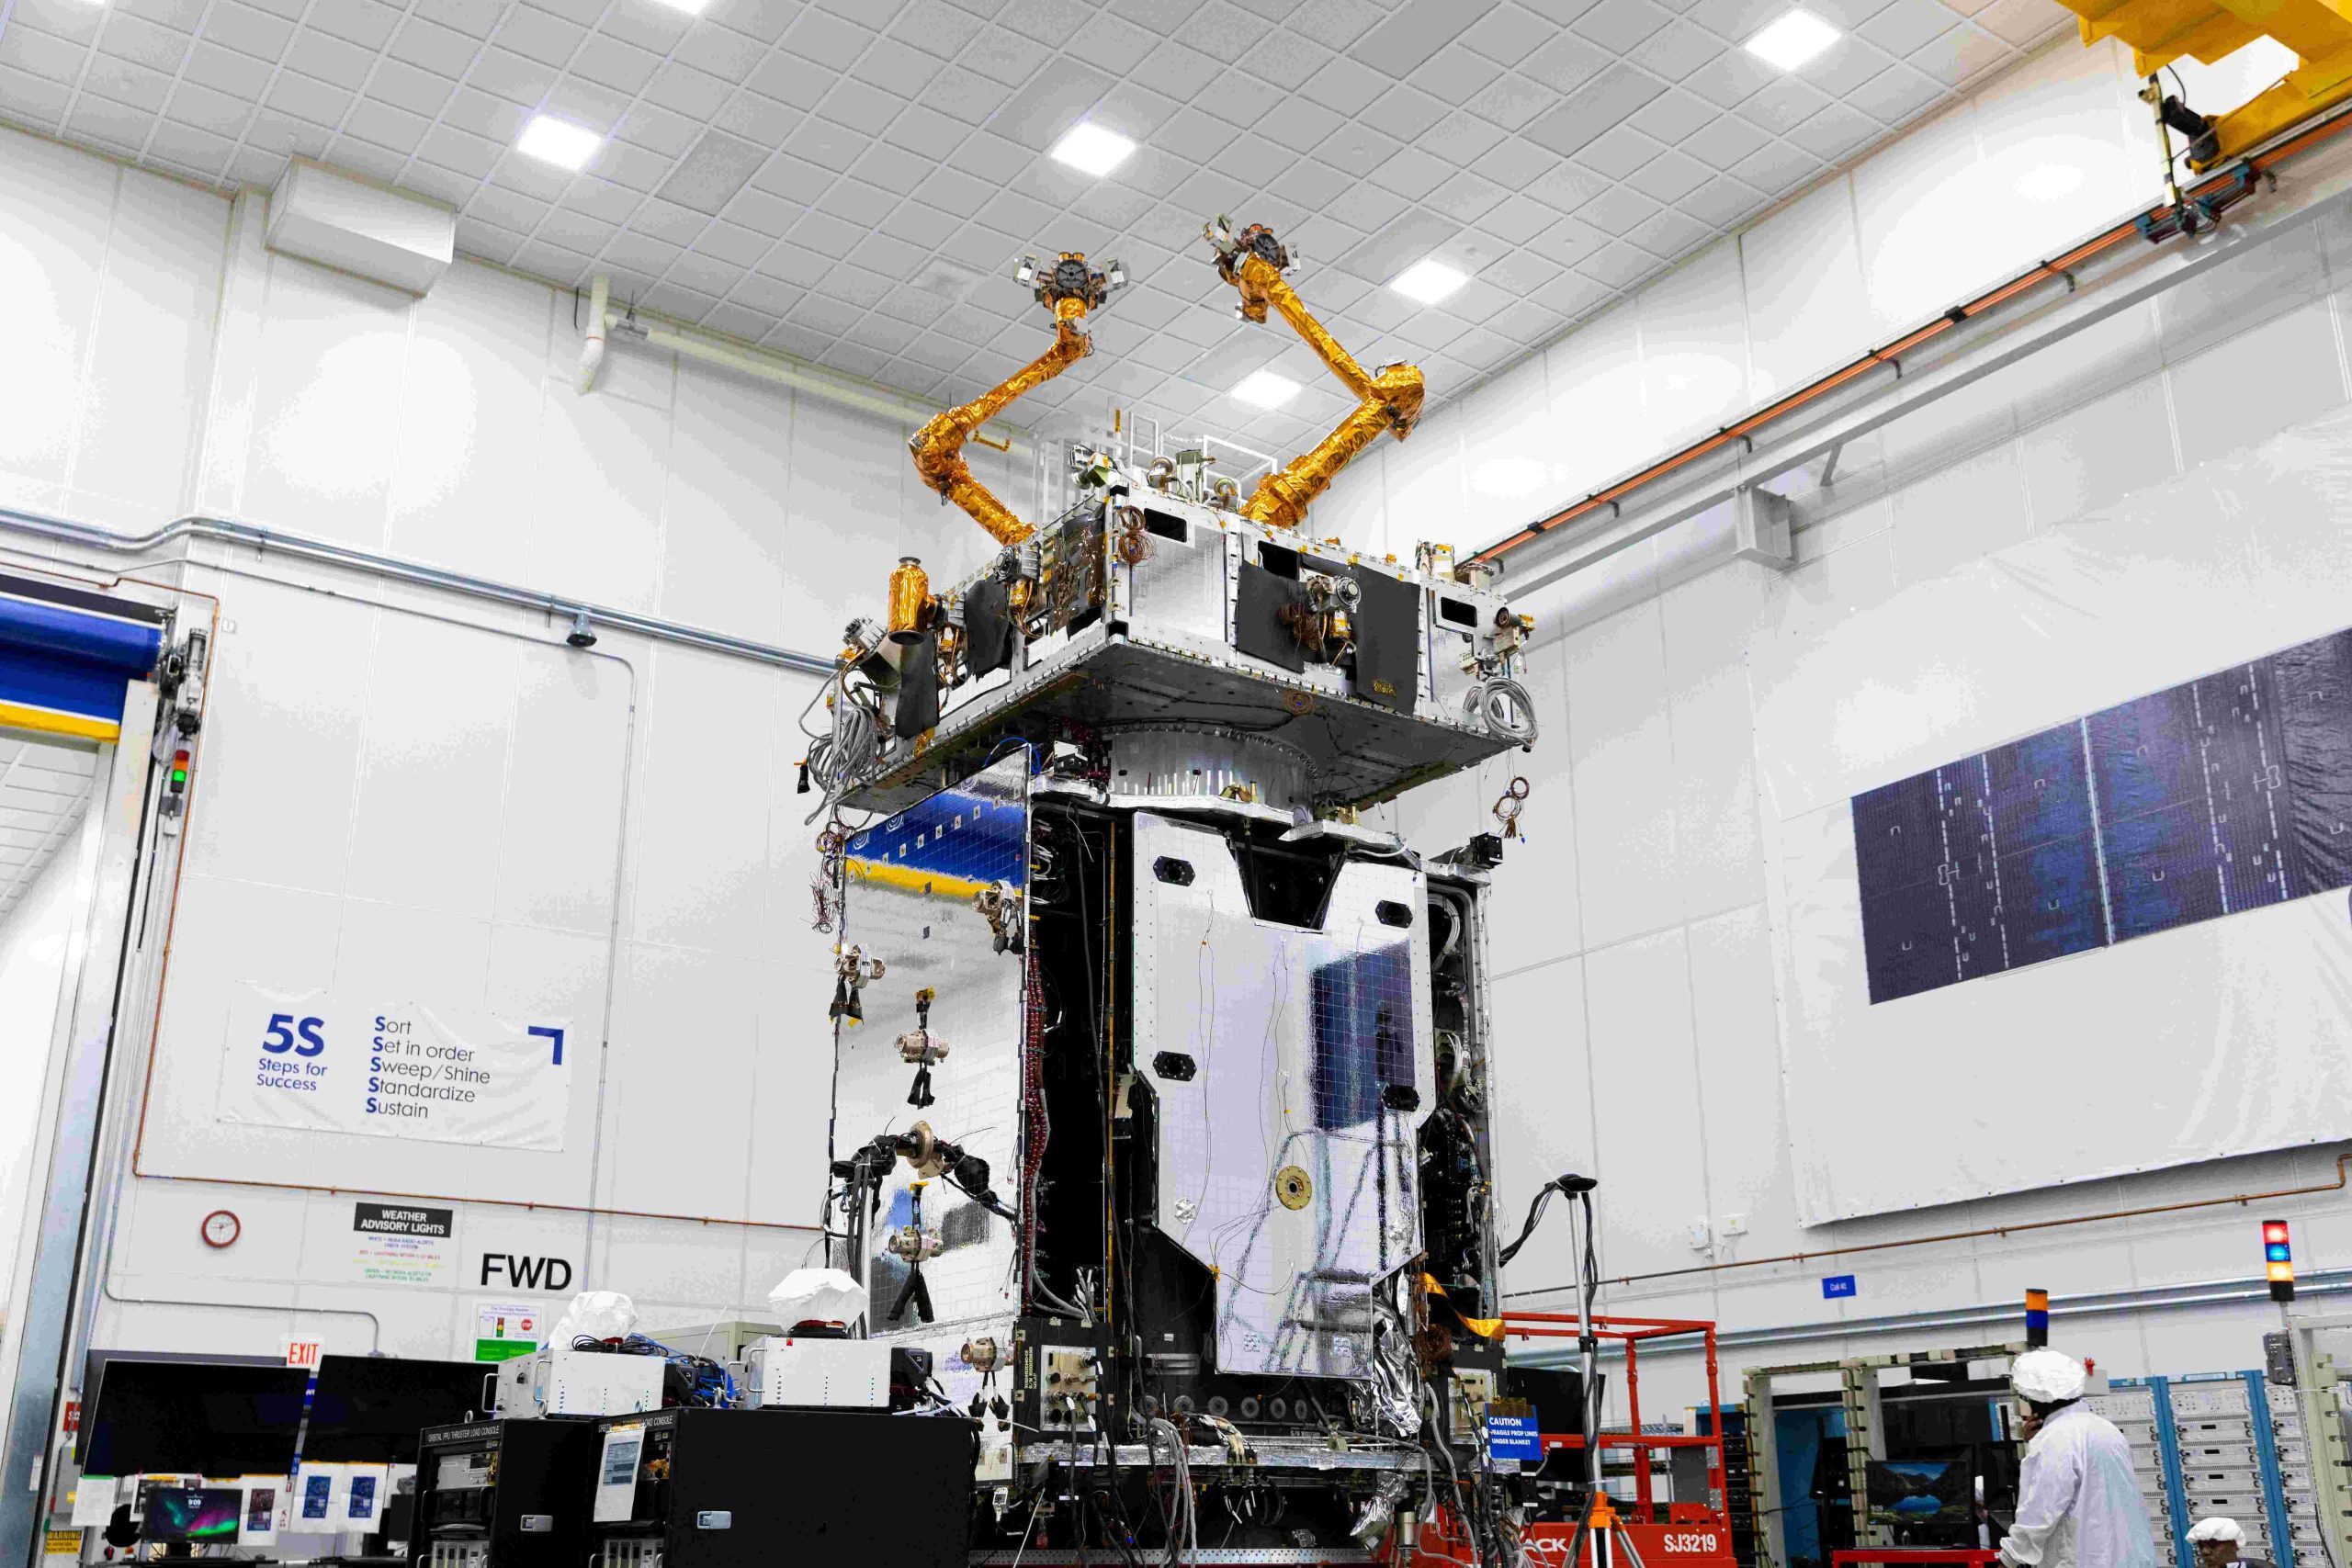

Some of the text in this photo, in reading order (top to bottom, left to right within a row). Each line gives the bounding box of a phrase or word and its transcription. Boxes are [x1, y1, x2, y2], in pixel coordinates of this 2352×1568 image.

[262, 1013, 324, 1057] 5S
[374, 1016, 412, 1035] Sort
[372, 1036, 476, 1062] Set in order
[258, 1057, 328, 1077] Steps for
[369, 1056, 491, 1084] Sweep/Shine
[256, 1073, 317, 1091] Success
[368, 1077, 476, 1103] Standardize
[366, 1097, 429, 1119] Sustain
[381, 1209, 428, 1223] WEATHER
[360, 1218, 445, 1235] ADVISORY LIGHTS
[481, 1253, 572, 1291] FWD
[288, 1343, 319, 1365] EXIT
[653, 1416, 673, 1426] CONSOLE
[1488, 1416, 1522, 1427] CAUTION
[451, 1429, 470, 1438] THRUSTER
[470, 1427, 481, 1438] LOAD
[481, 1425, 500, 1436] CONSOLE
[47, 1530, 81, 1540] WARNING
[1664, 1533, 1716, 1552] SJ3219
